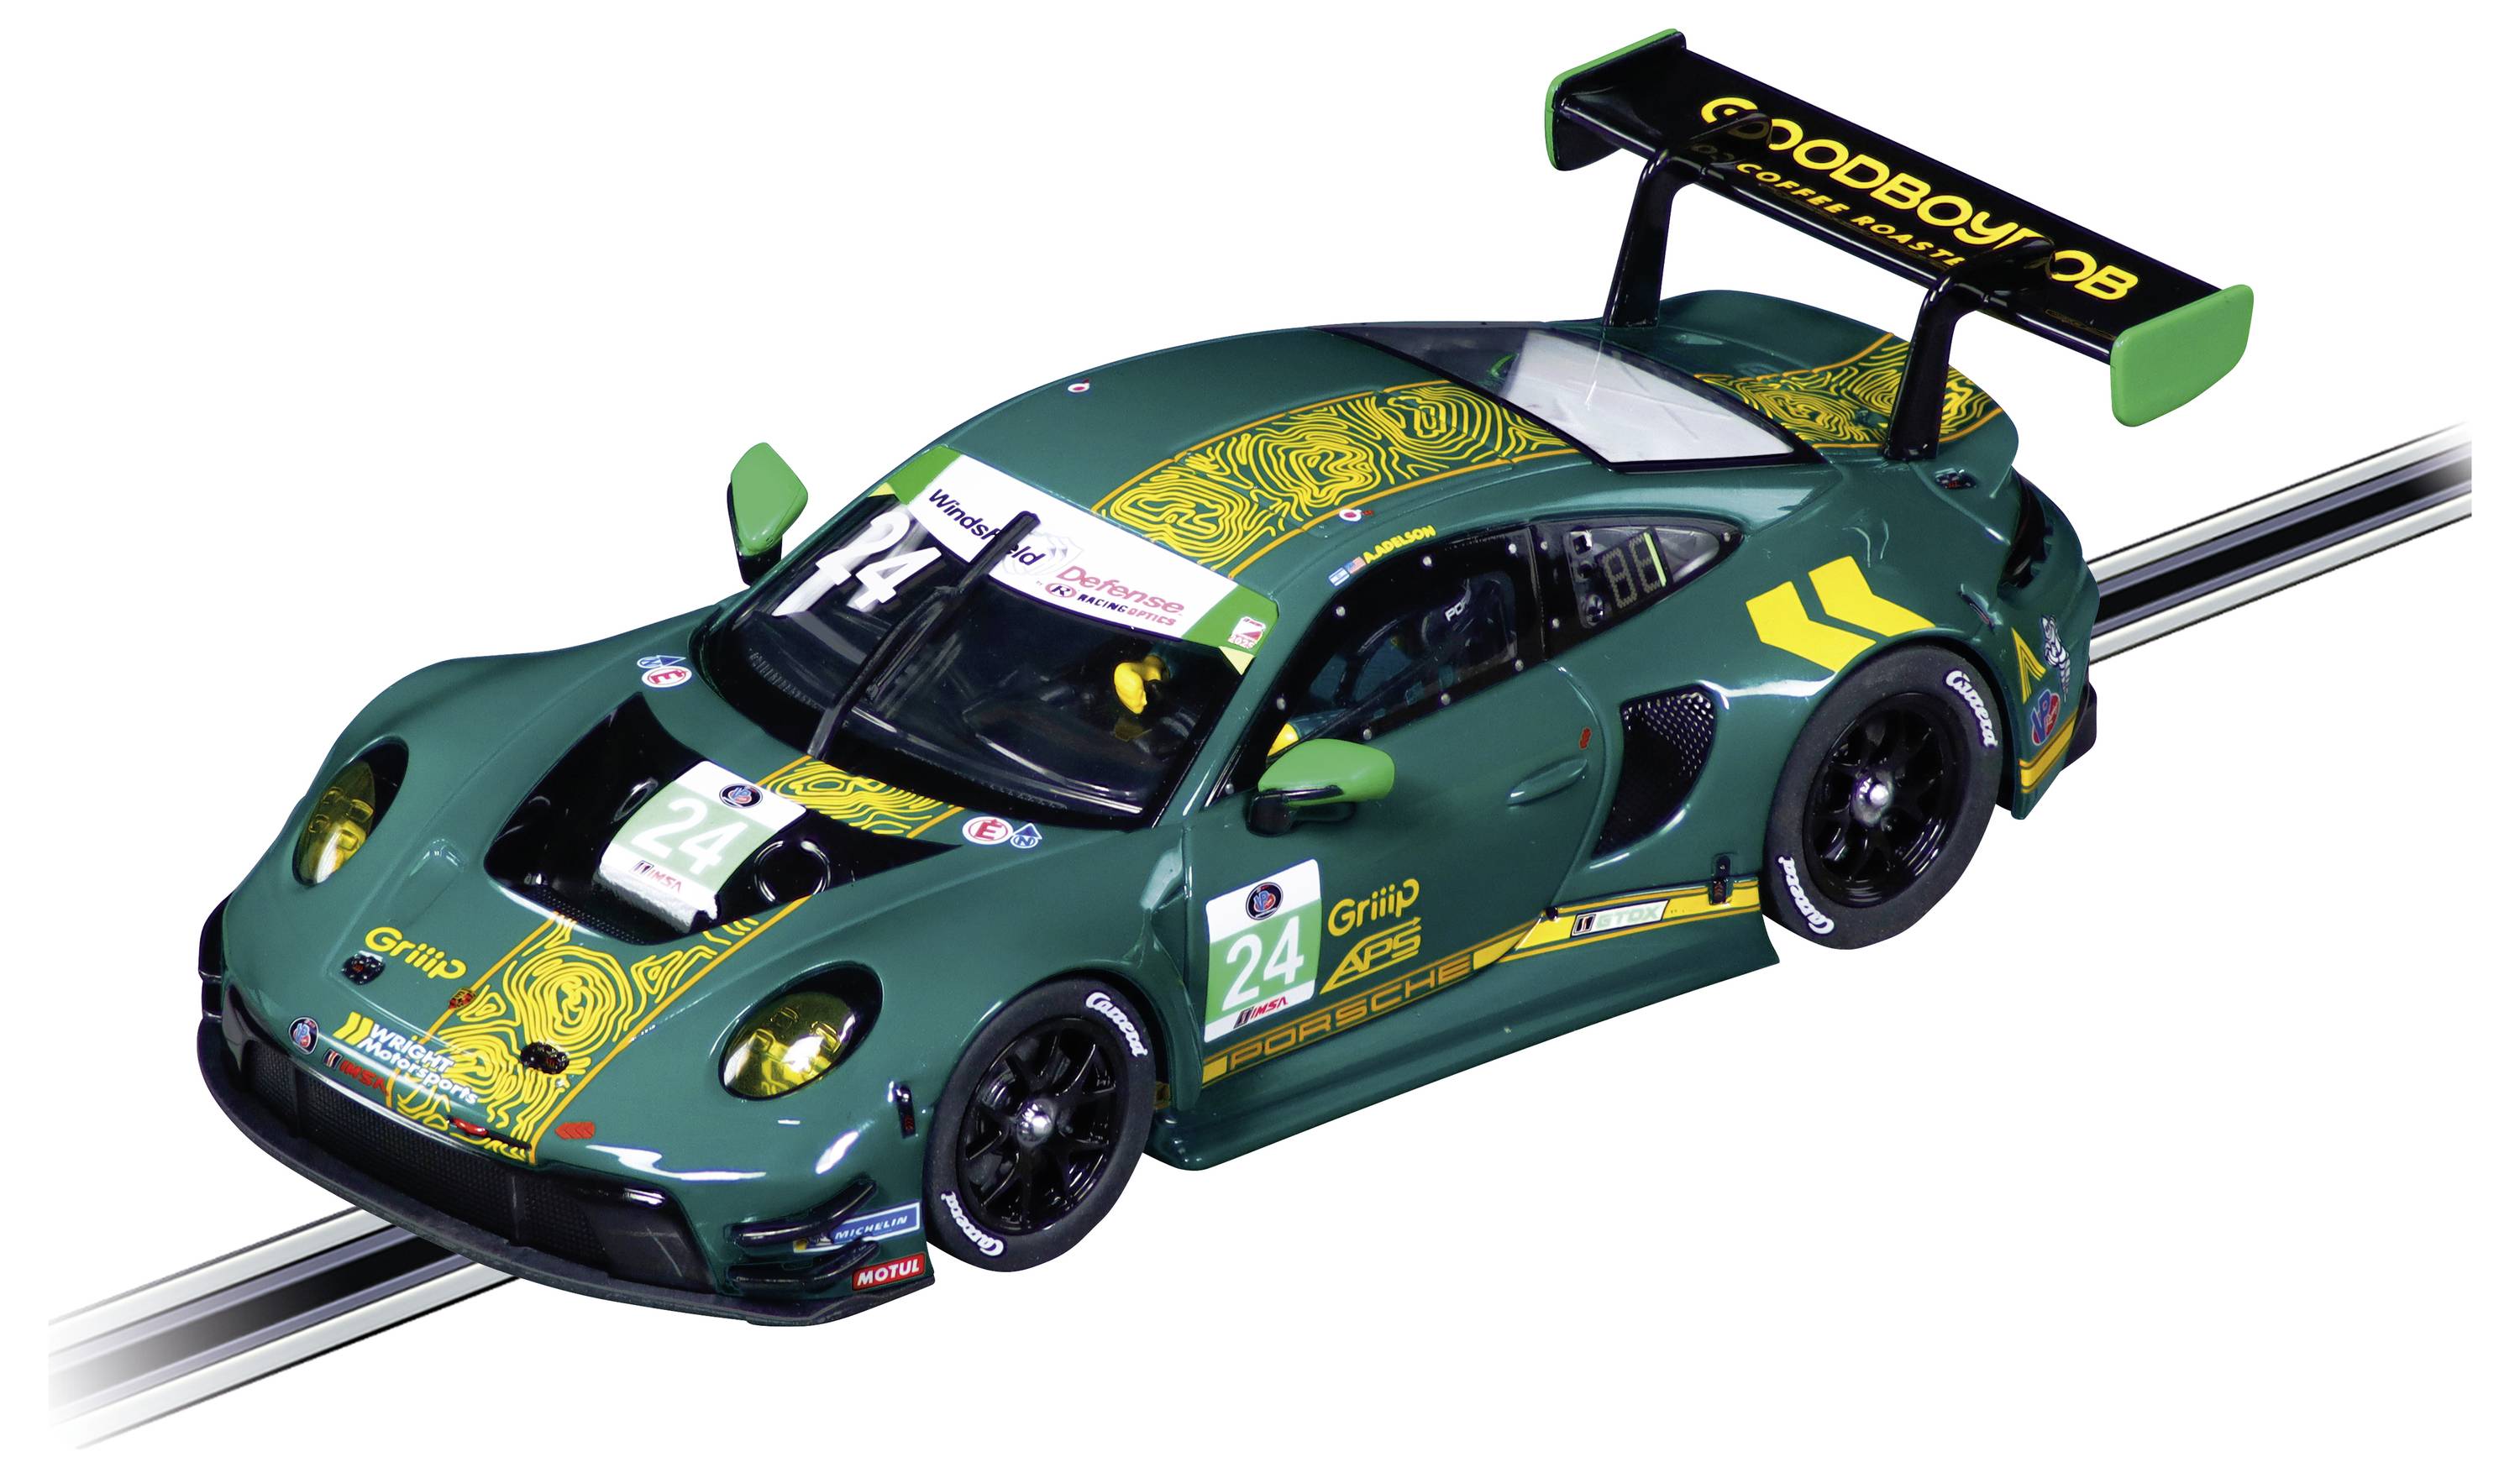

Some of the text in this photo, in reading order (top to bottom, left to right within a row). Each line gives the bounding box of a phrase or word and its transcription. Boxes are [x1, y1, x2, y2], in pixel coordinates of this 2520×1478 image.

[1736, 163, 1966, 266] COFFEE ROASTE
[1056, 565, 1184, 613] Defense
[1077, 594, 1128, 612] RACING
[1126, 608, 1176, 626] OPTICS
[631, 797, 748, 875] 24
[647, 868, 682, 893] IMSA
[1327, 878, 1420, 937] Griiip
[365, 926, 467, 979] Griiip
[1221, 915, 1305, 1012] 24
[1320, 916, 1422, 995] APS
[1230, 955, 1472, 1072] PORSCHE
[1250, 996, 1289, 1019] IMSA
[356, 1037, 480, 1105] Motorsports
[370, 1023, 456, 1073] WRIGHT
[339, 1060, 390, 1098] IMSA
[834, 1216, 908, 1240] MICHELIN
[857, 1259, 920, 1286] MOTUL
